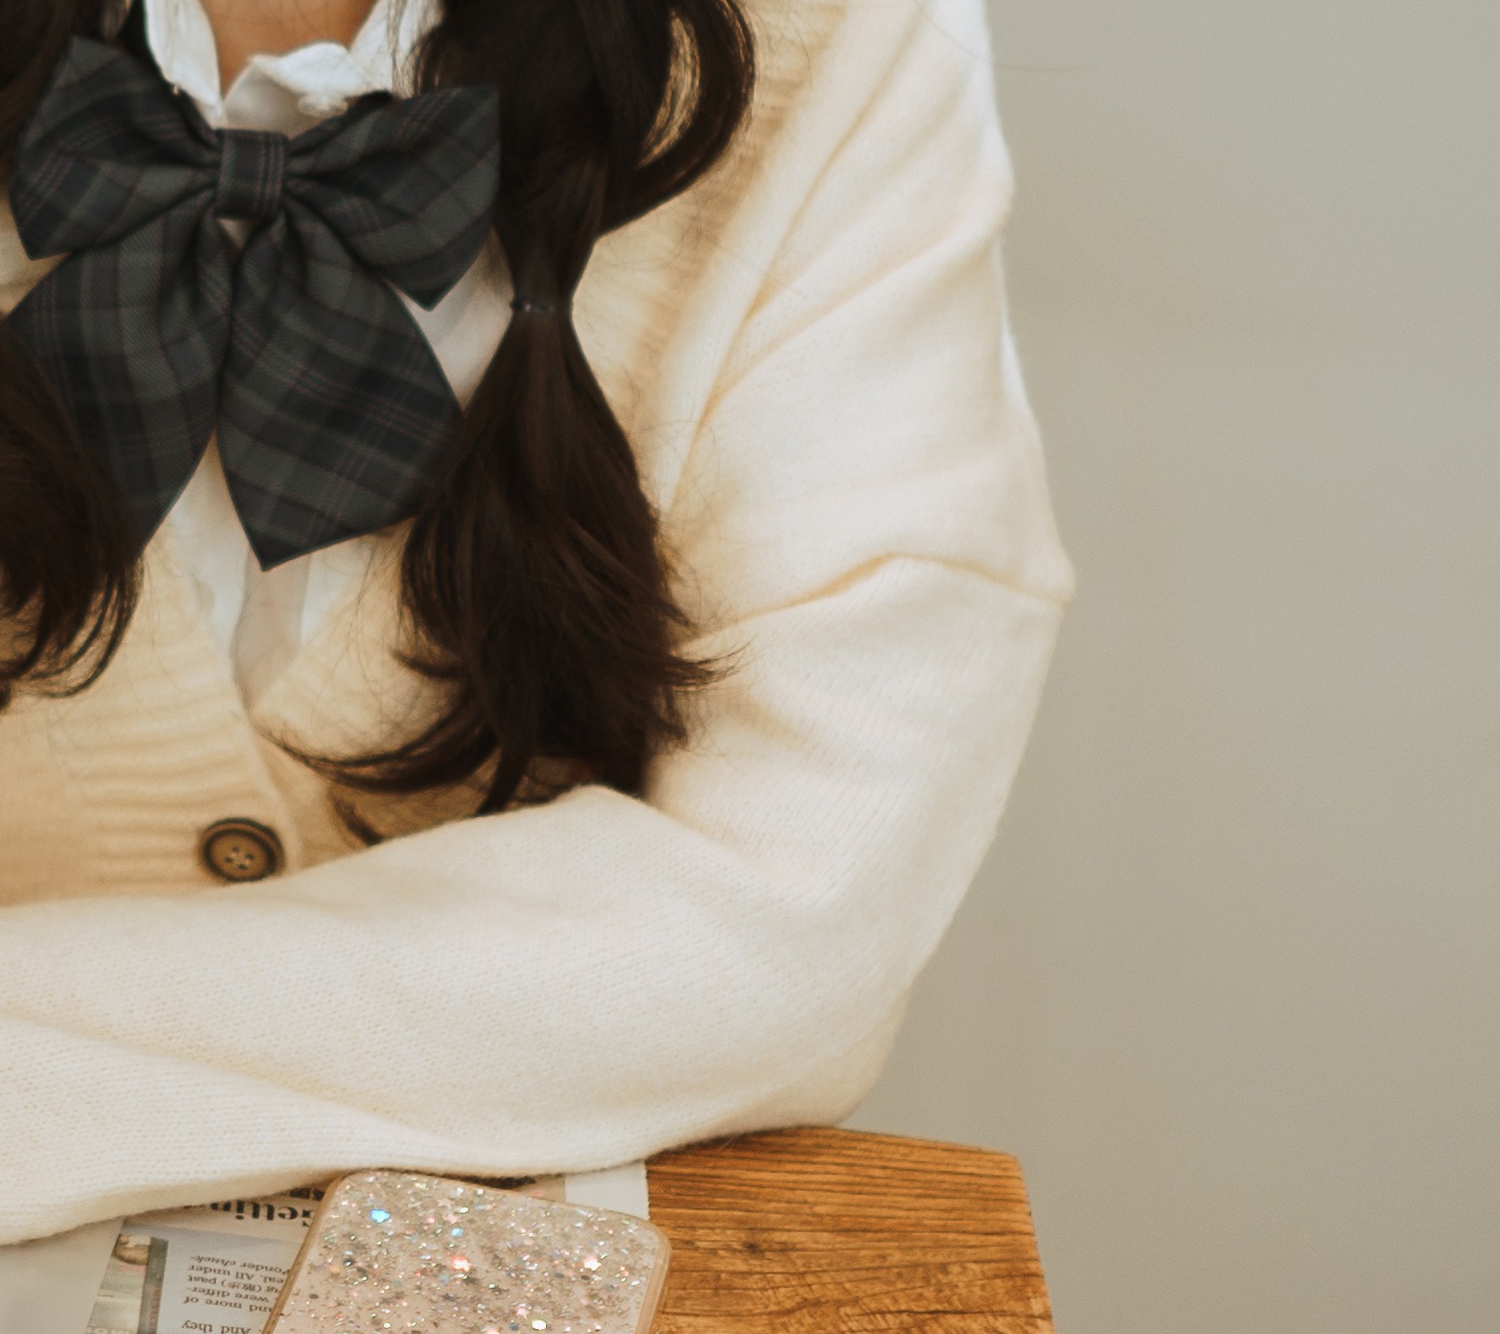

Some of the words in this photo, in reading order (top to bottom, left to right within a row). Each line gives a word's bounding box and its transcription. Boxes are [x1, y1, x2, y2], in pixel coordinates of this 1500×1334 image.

[188, 1265, 230, 1276] under
[188, 1276, 217, 1285] past
[235, 1272, 254, 1281] All
[183, 1297, 199, 1305] of
[235, 1293, 269, 1303] were
[205, 1299, 242, 1309] more
[181, 1320, 213, 1333] they
